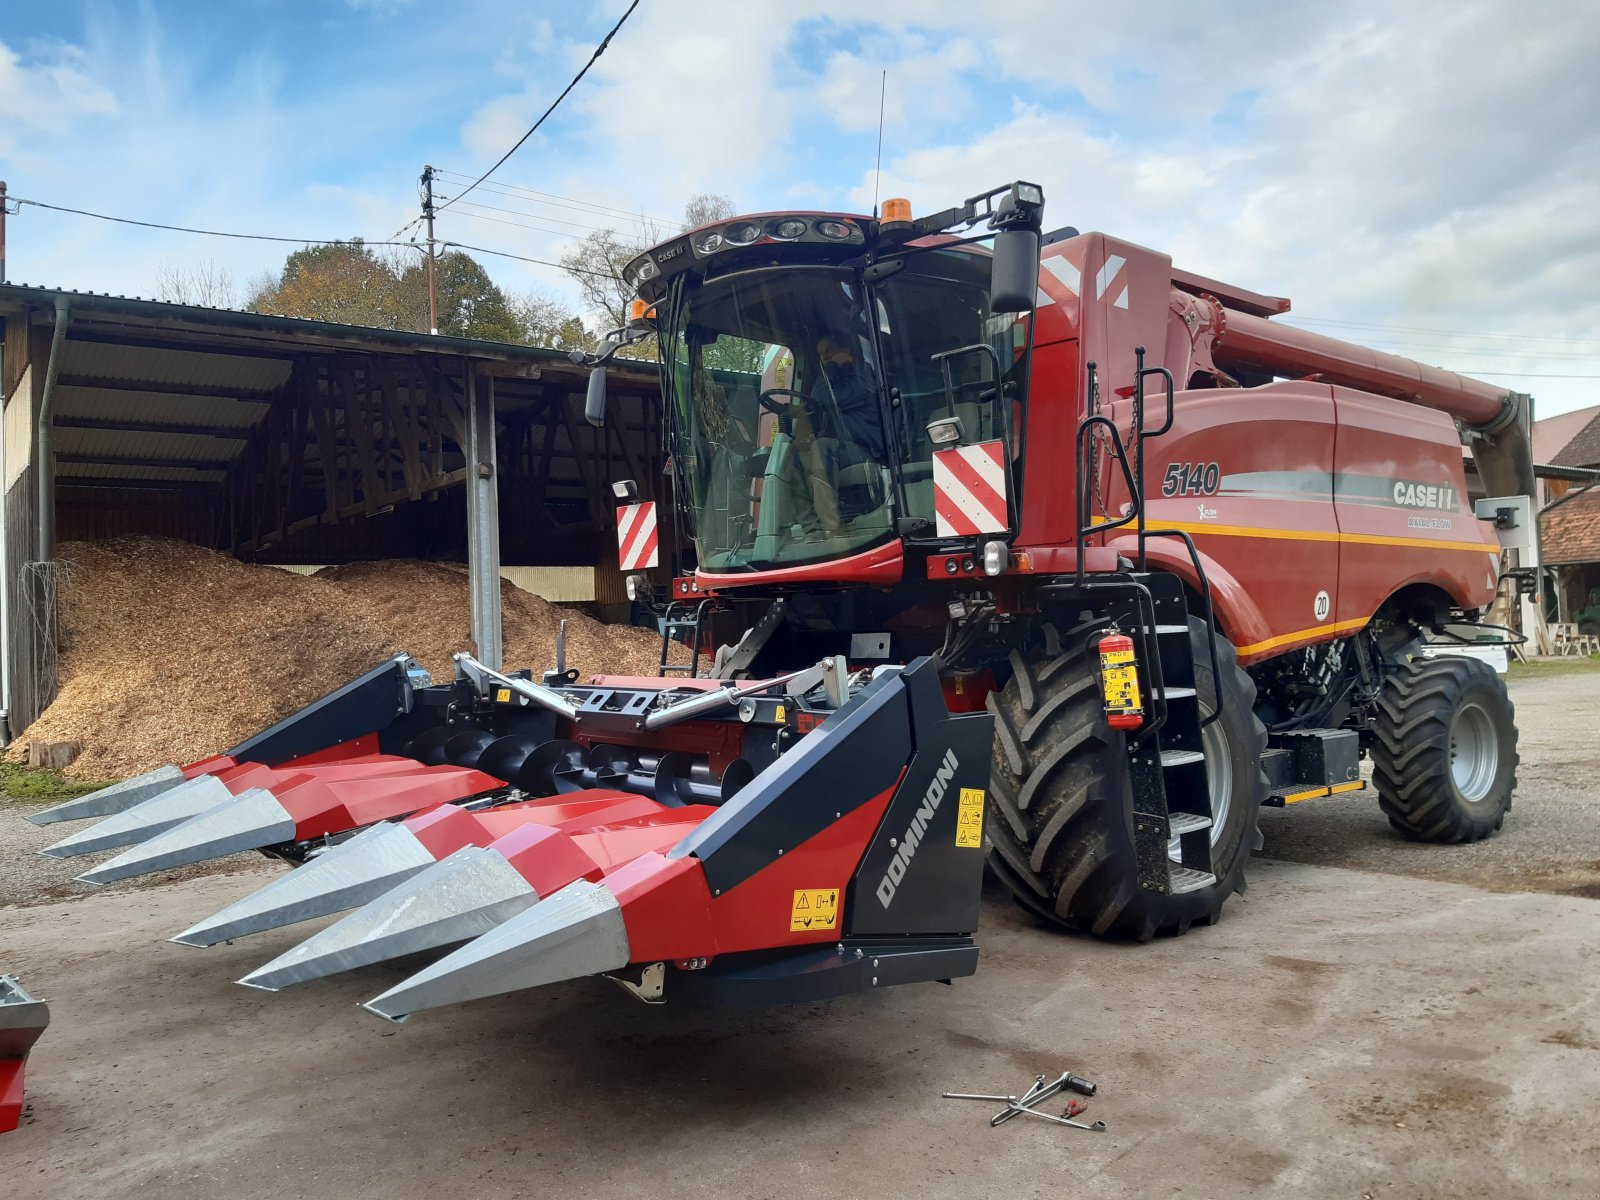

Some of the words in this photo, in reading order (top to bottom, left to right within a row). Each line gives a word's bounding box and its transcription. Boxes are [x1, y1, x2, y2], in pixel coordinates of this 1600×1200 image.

[658, 249, 676, 263] CASE
[1161, 461, 1219, 498] 5140
[1393, 481, 1437, 507] CASE
[1317, 596, 1327, 615] 20
[876, 747, 959, 910] DOMINONI
